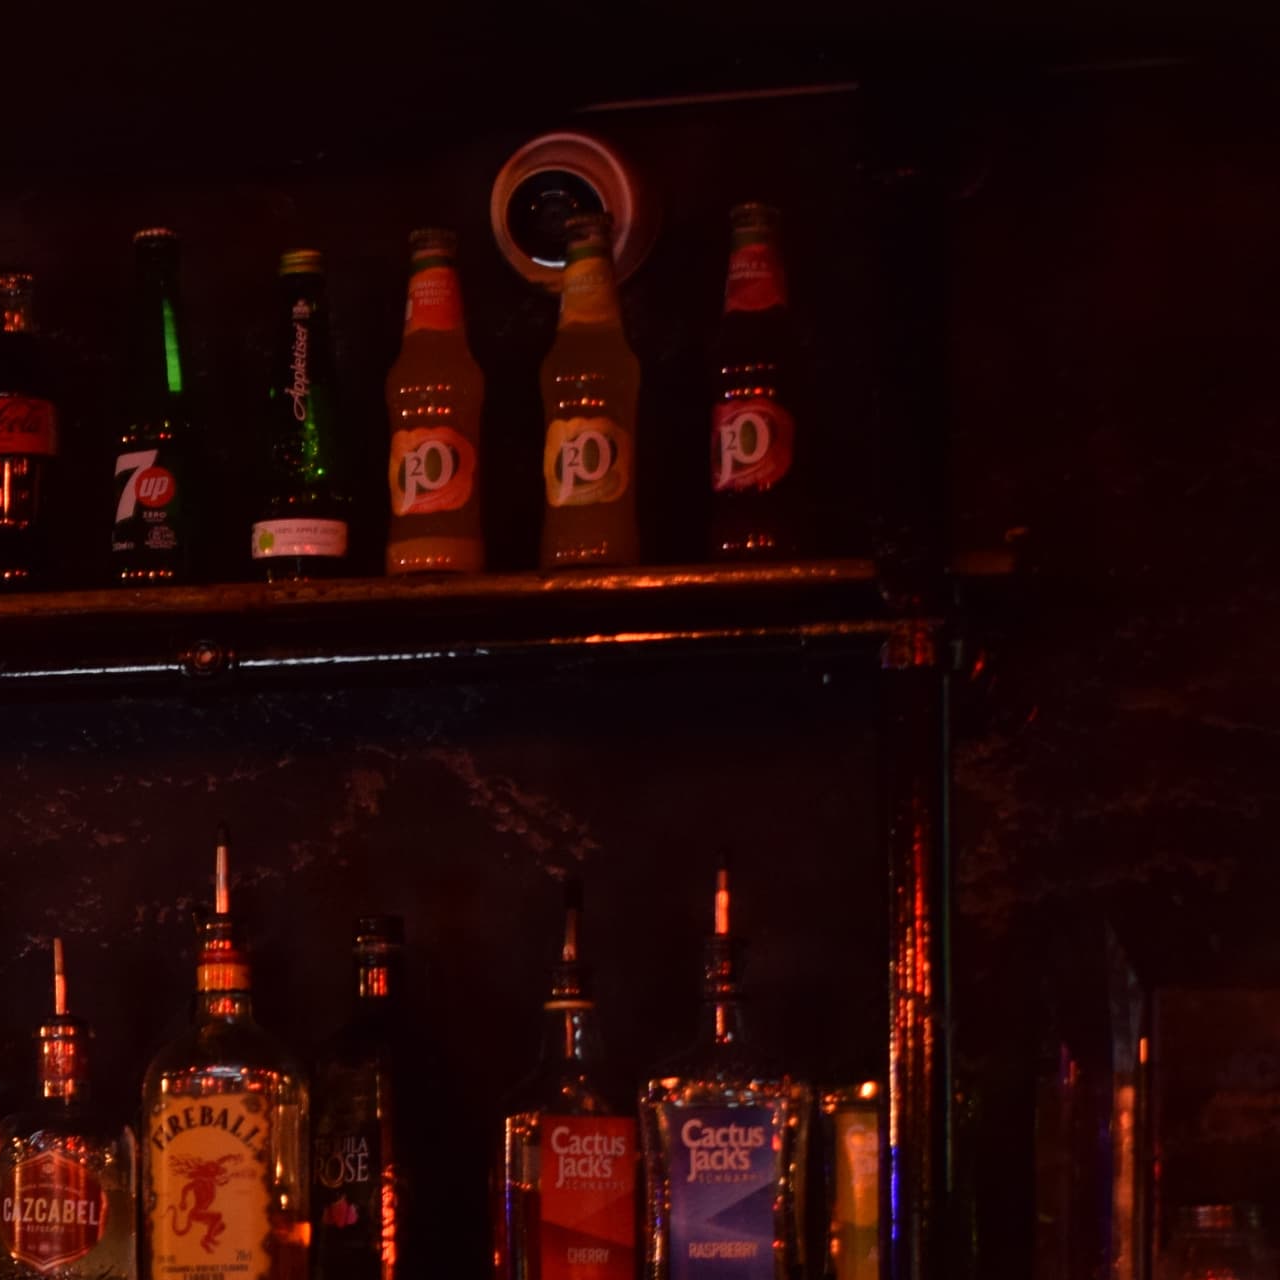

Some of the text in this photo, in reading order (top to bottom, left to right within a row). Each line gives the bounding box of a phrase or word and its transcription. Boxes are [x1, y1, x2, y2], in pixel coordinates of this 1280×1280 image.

[150, 1105, 262, 1153] FIREBALL
[313, 1135, 369, 1154] TEQUILA
[550, 1125, 626, 1158] Cactus
[680, 1118, 766, 1149] Cactus
[554, 1152, 613, 1189] Jack's
[685, 1147, 752, 1183] Jack's
[2, 1196, 100, 1227] CAZCABEL
[566, 1247, 611, 1265] CHERRY
[688, 1241, 759, 1260] RASPBERRY
